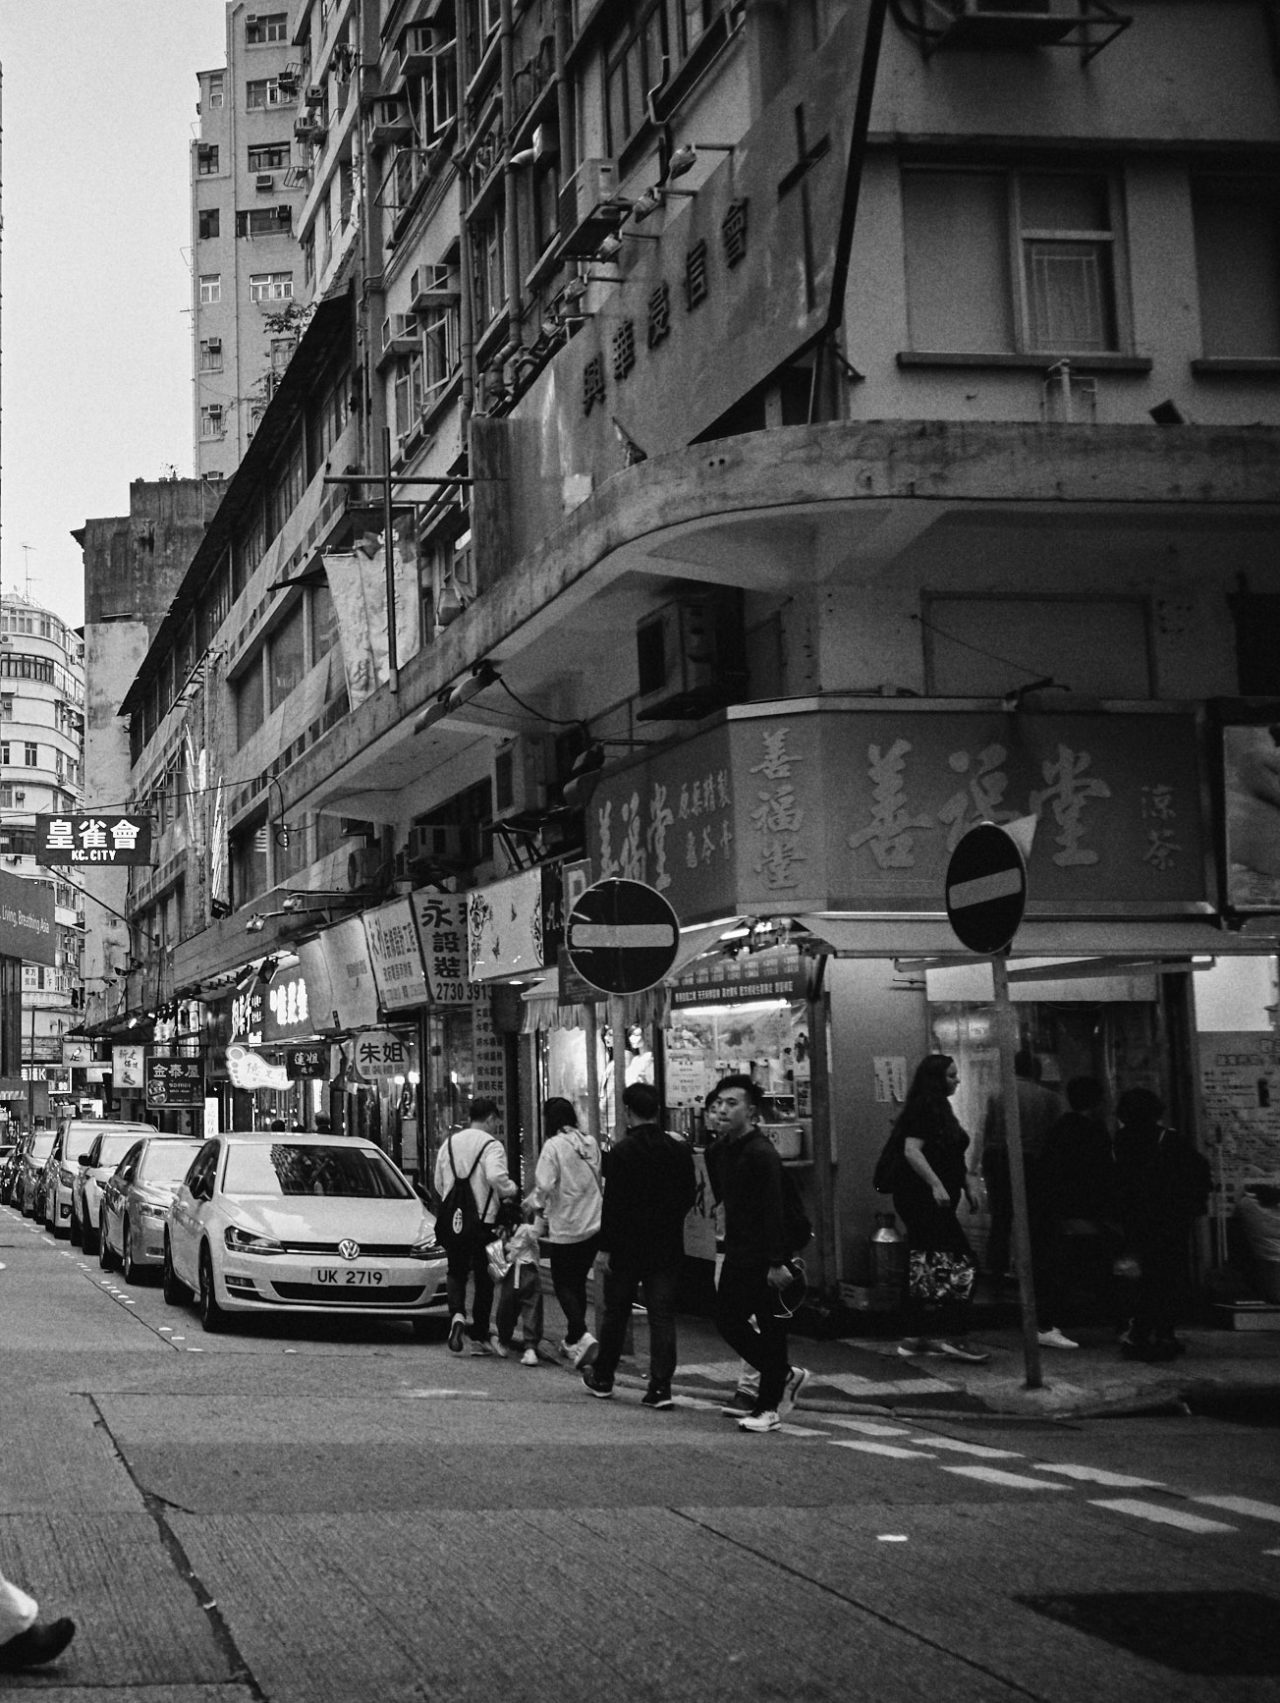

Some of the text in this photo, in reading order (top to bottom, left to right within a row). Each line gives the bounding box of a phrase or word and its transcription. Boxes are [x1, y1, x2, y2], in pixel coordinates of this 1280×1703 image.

[46, 819, 140, 849] 皇雀會
[436, 982, 464, 1001] 2730
[360, 1042, 404, 1063] 朱姐
[318, 1270, 383, 1285] UK 2719
